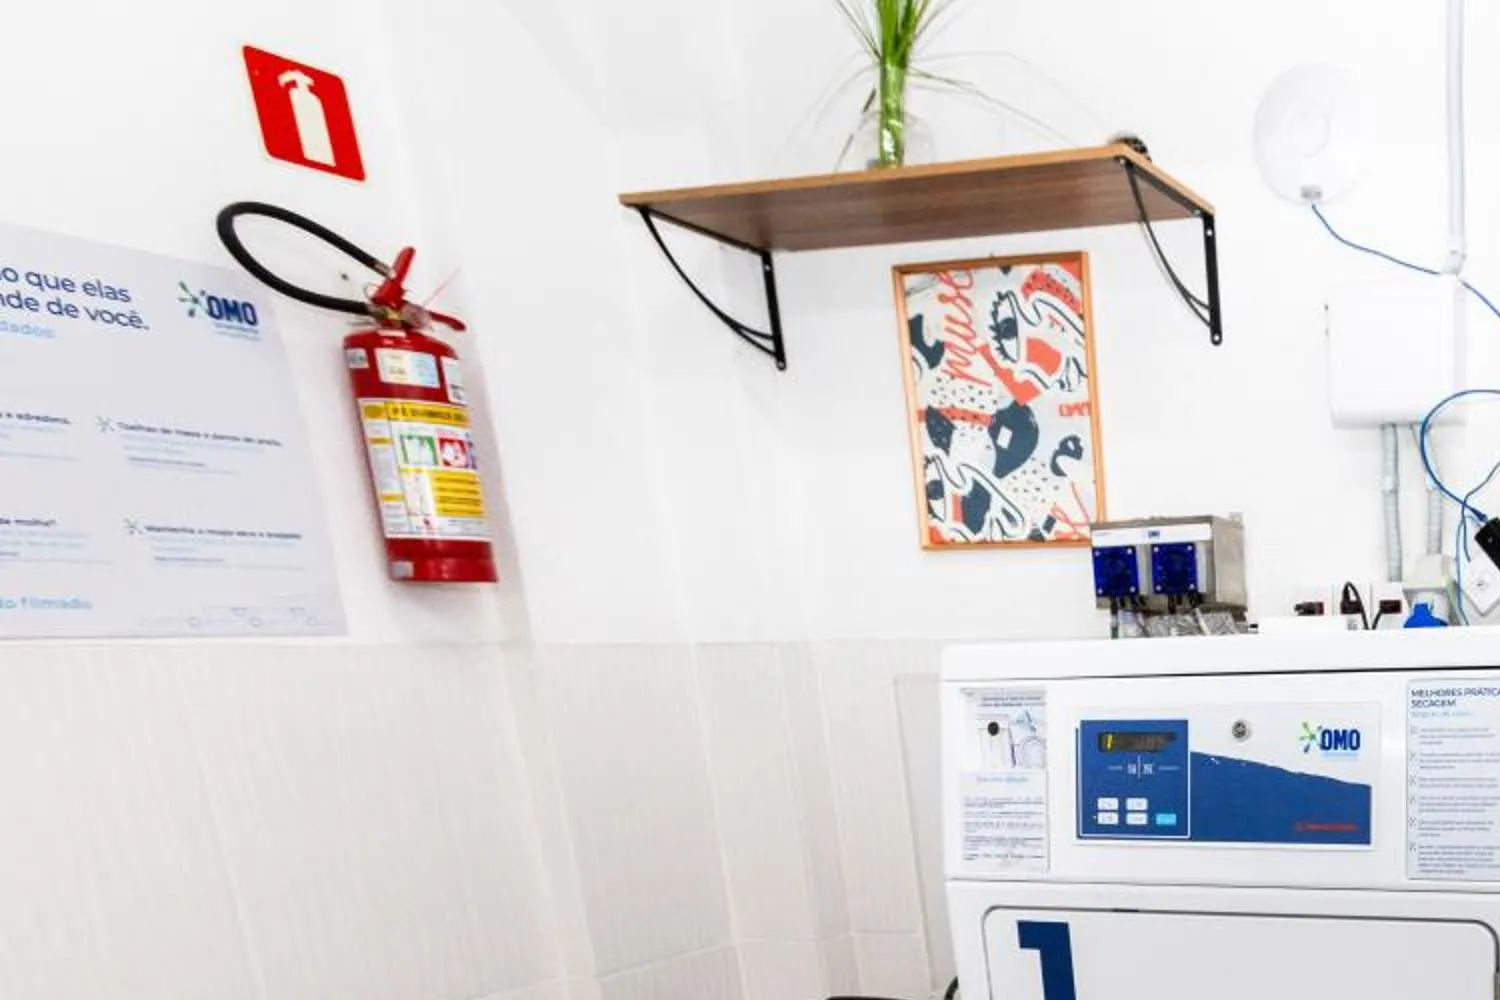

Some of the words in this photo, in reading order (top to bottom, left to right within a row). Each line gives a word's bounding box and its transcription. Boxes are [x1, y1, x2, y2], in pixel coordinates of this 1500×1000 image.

[25, 271, 76, 293] que
[82, 278, 132, 303] elas
[46, 298, 80, 319] de
[83, 305, 150, 331] você.
[206, 295, 258, 326] OMO
[1319, 729, 1361, 751] OMO
